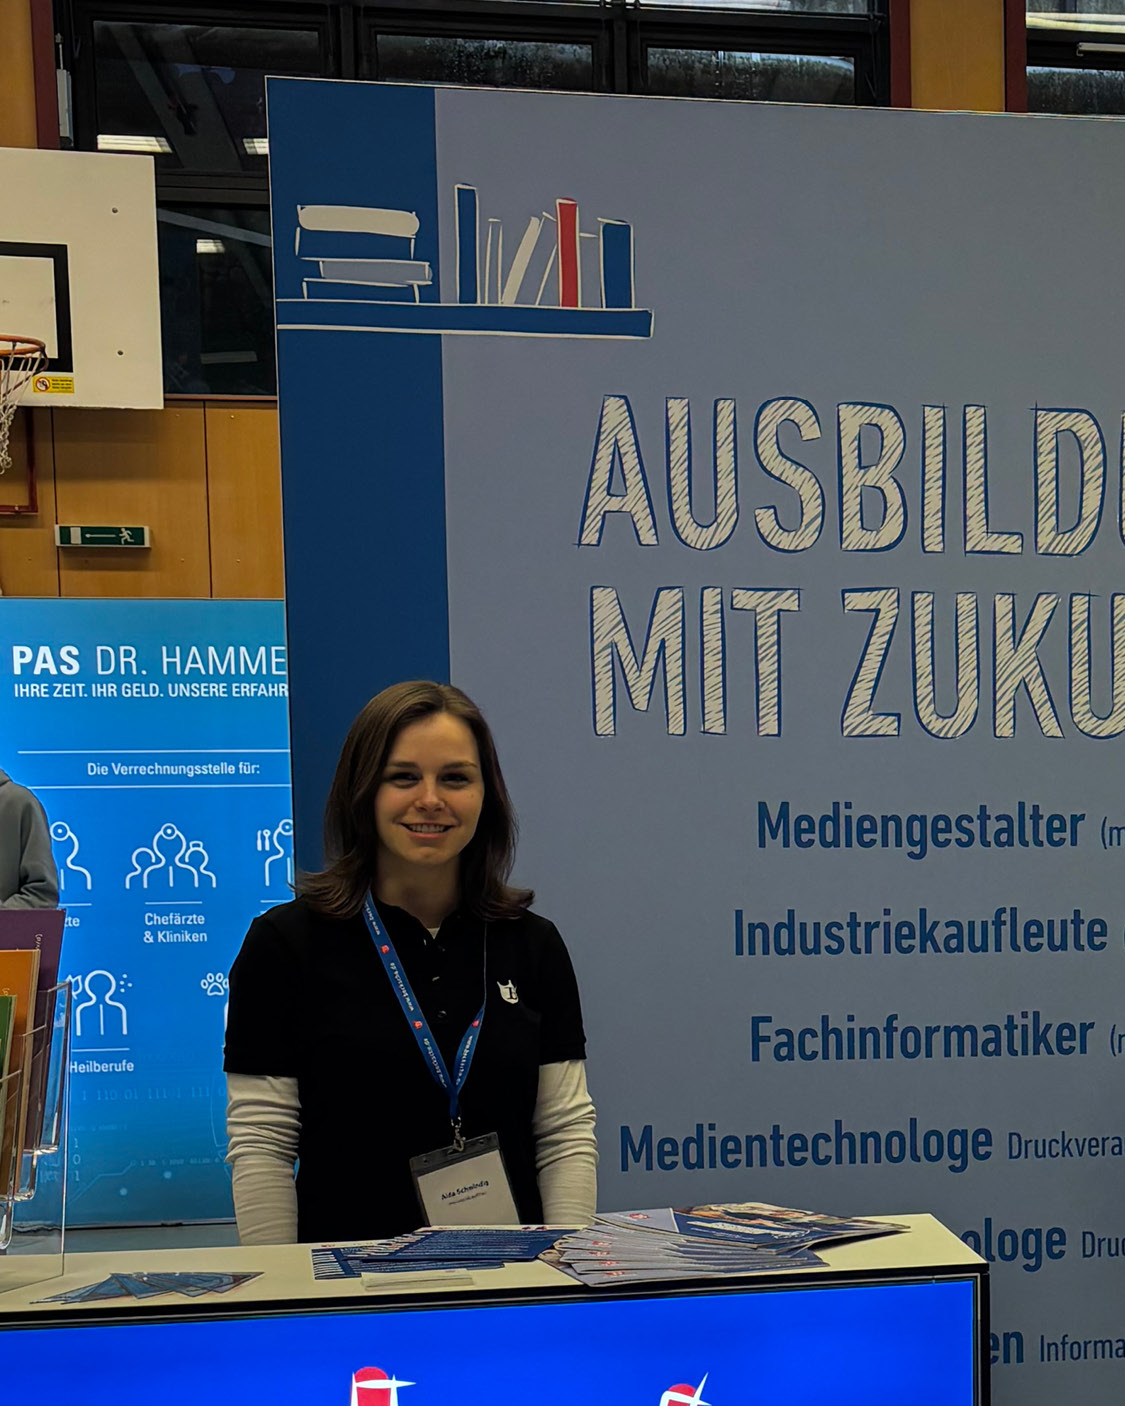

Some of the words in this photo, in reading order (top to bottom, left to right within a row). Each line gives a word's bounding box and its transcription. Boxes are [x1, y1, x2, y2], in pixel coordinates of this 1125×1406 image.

[12, 645, 80, 676] PAS
[96, 645, 148, 676] DR.
[162, 645, 287, 676] HAMME
[590, 585, 802, 738] MIT
[14, 684, 49, 698] IHRE
[53, 684, 88, 697] ZEIT.
[92, 684, 118, 697] IHR
[121, 684, 164, 697] GELD.
[168, 683, 228, 697] UNSERE
[232, 683, 288, 697] ERFAHR
[87, 763, 109, 776] Die
[112, 762, 236, 777] Verrechnungsstelle
[238, 762, 260, 775] für:
[757, 801, 1086, 860] Mediengestalter
[145, 912, 206, 926] Chefärzte
[734, 907, 1109, 956] Industriekaufleute
[143, 931, 154, 943] &
[157, 930, 208, 943] Kliniken
[751, 1011, 1096, 1062] Fachinformatiker
[70, 1060, 134, 1073] Heilberufe
[619, 1118, 993, 1173] Medientechnologe
